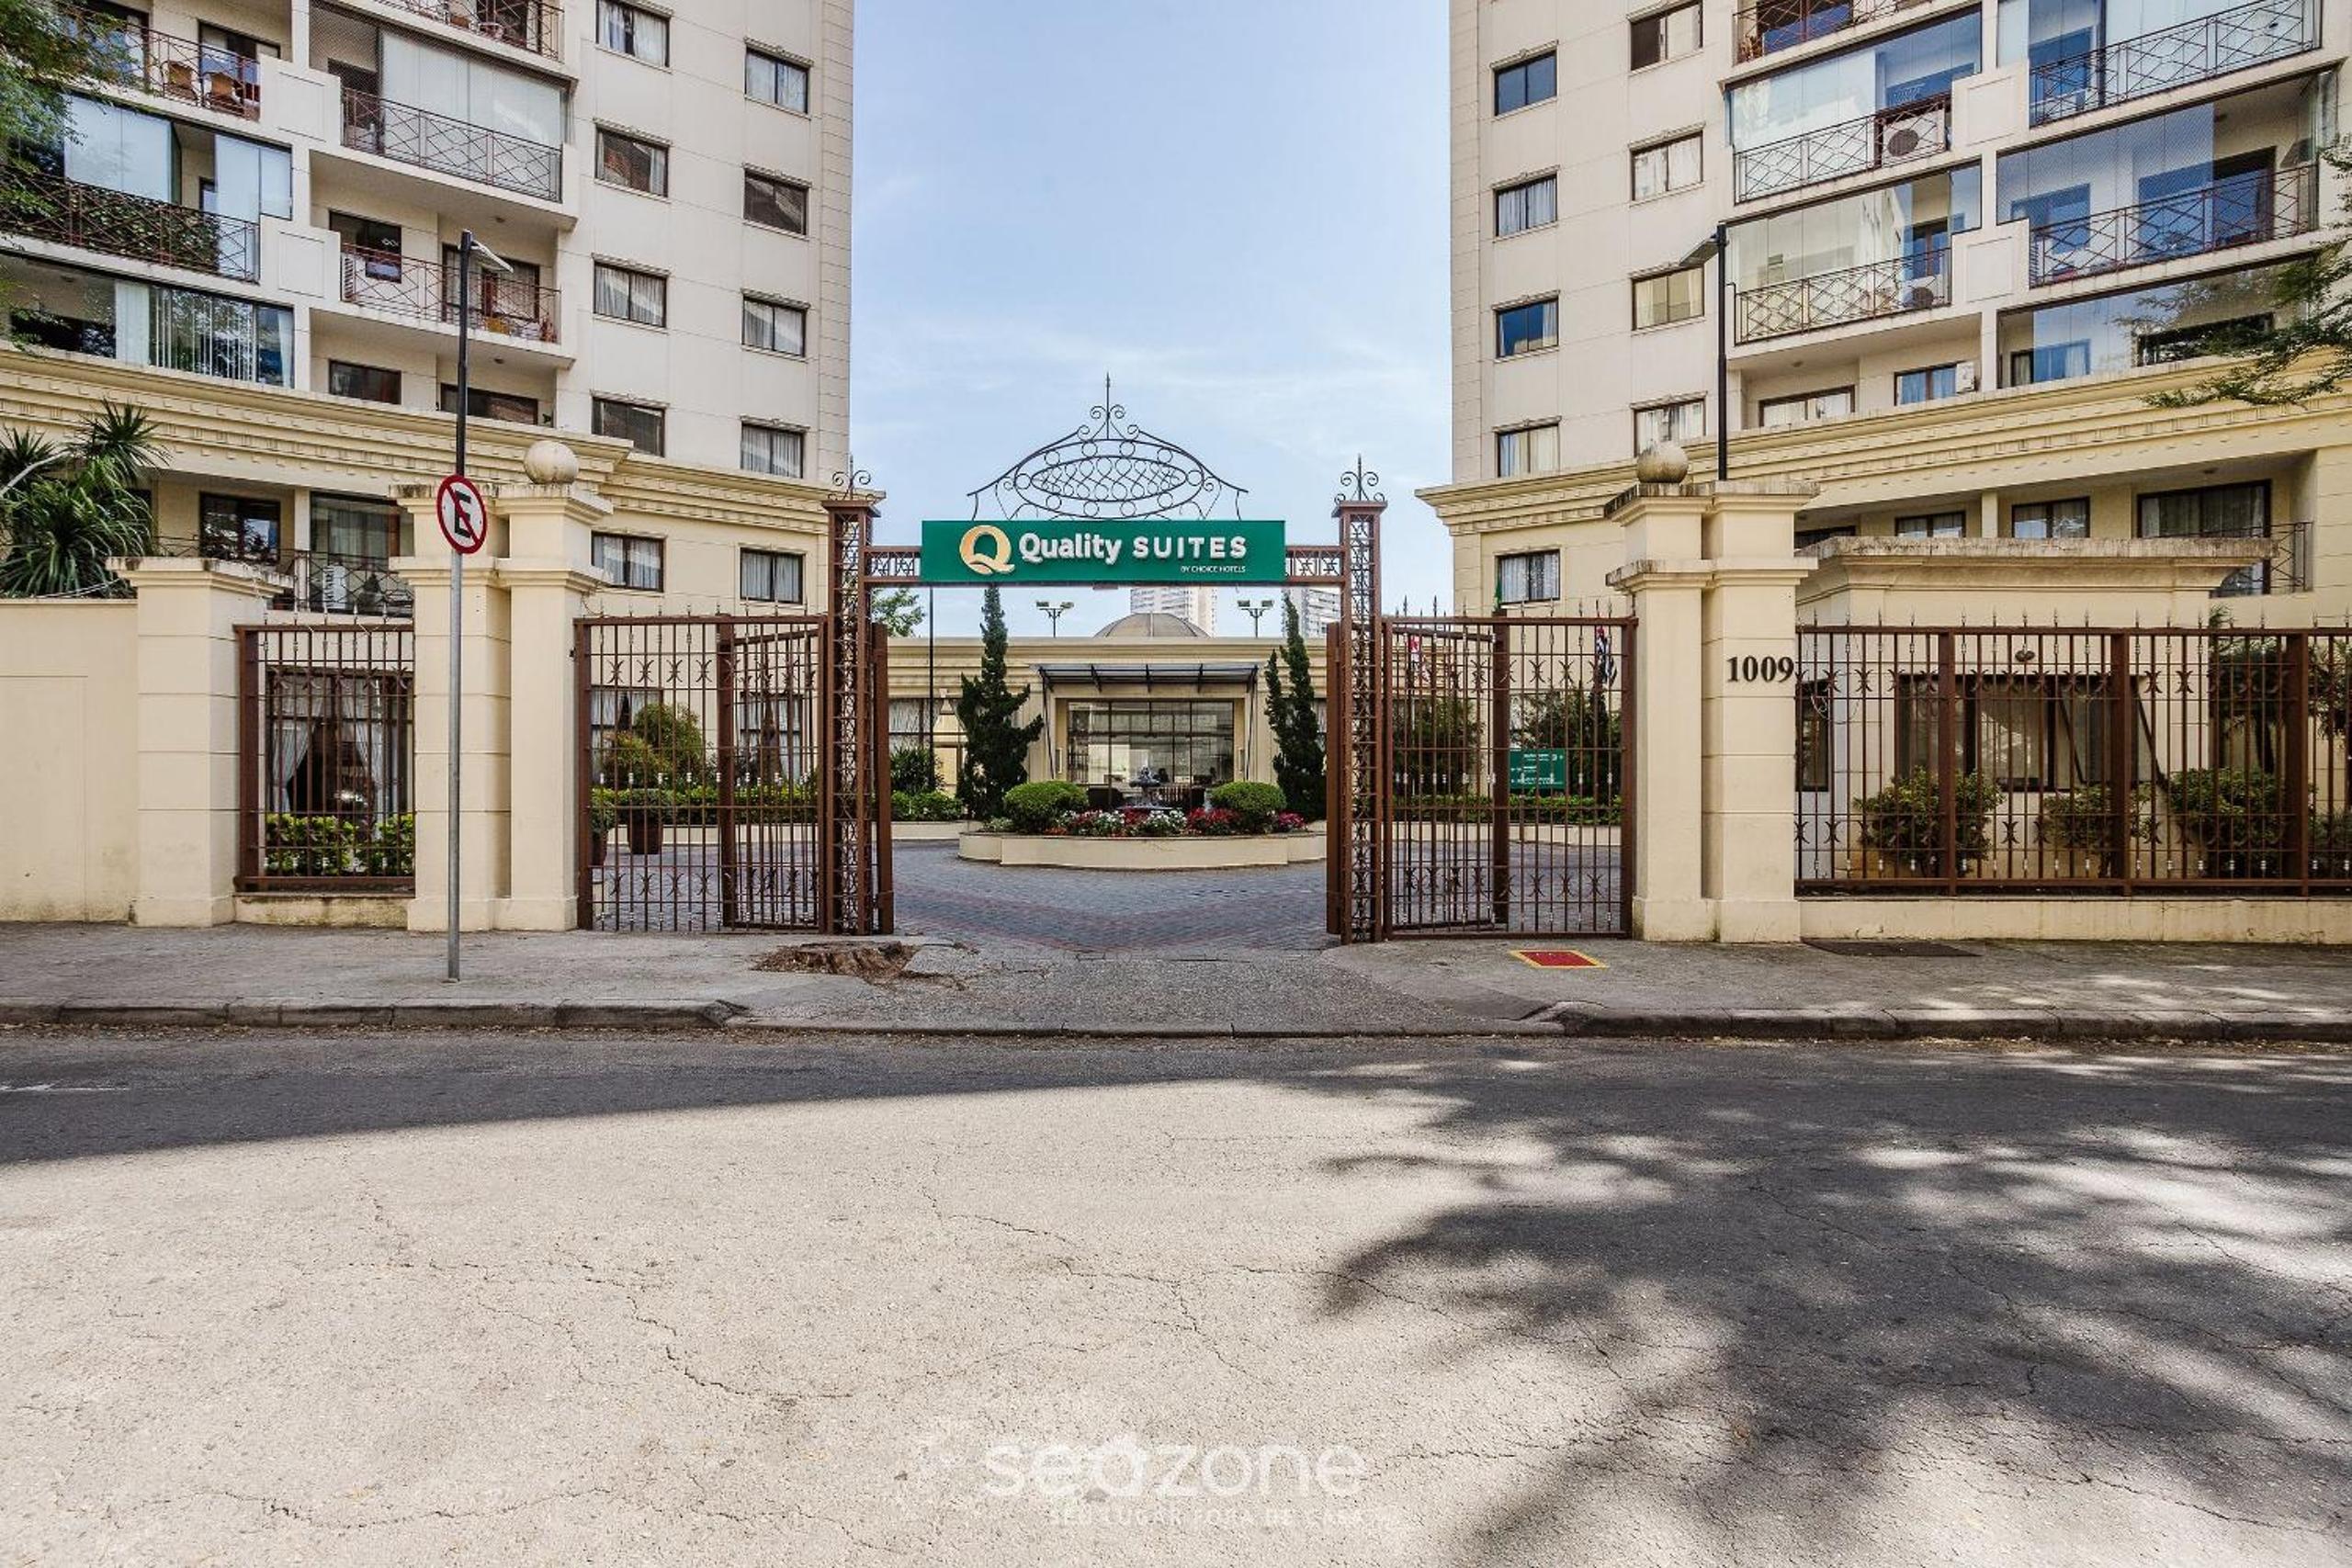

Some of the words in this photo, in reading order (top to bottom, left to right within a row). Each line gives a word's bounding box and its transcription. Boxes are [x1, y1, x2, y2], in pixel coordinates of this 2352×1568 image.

[1019, 532, 1122, 565] Quality
[1132, 536, 1248, 558] SUITES
[1191, 565, 1218, 573] CHOICE
[1219, 565, 1246, 573] HOTELS
[1726, 656, 1794, 682] 1009
